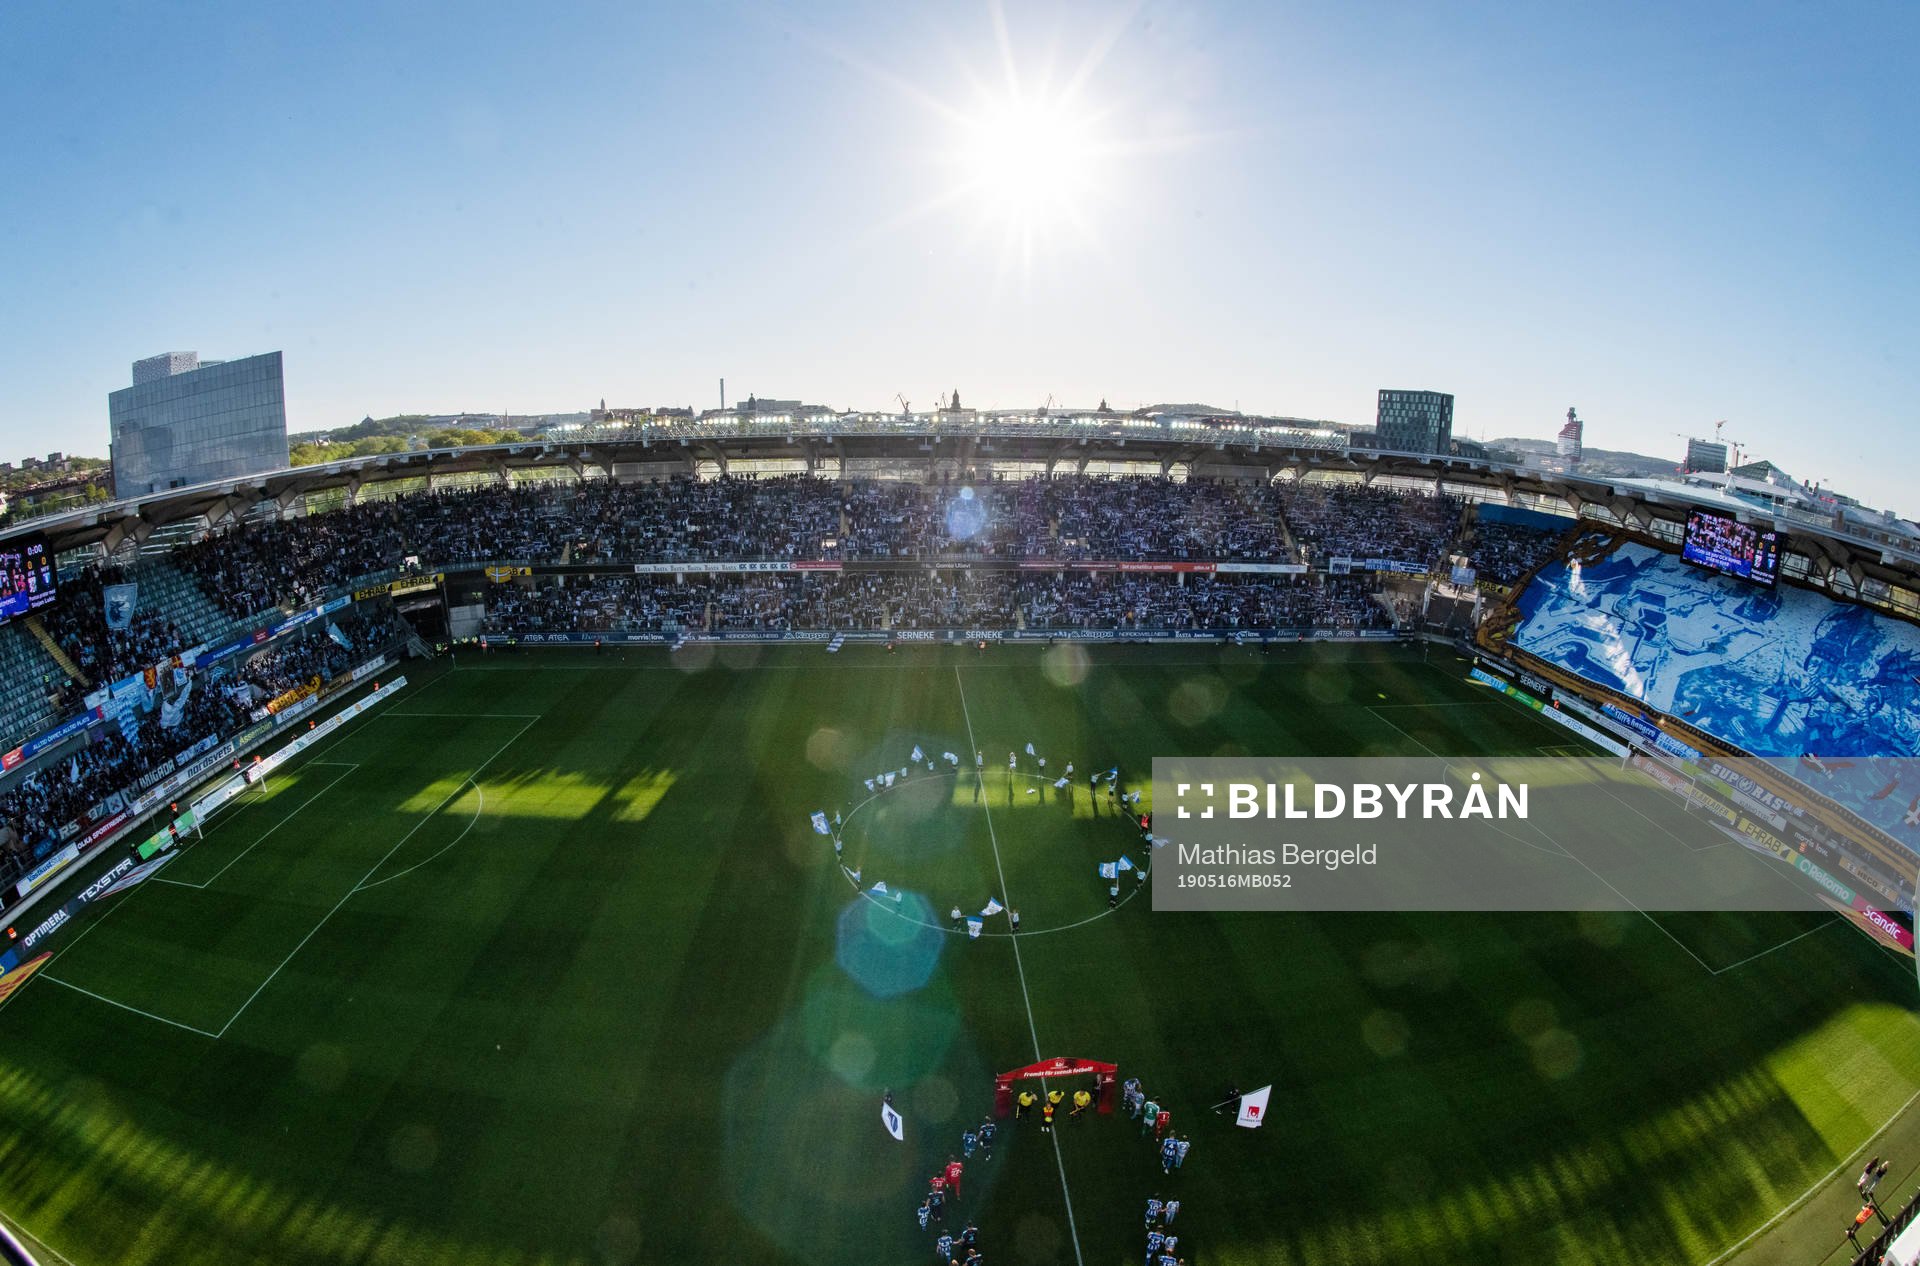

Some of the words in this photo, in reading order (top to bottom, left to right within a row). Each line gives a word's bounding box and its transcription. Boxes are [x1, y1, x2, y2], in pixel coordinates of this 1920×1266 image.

[28, 544, 43, 556] 0:00
[359, 585, 386, 599] EHRAB
[401, 576, 431, 588] EHRAB
[795, 632, 830, 640] Kappa
[897, 632, 935, 640] SERNEKE
[965, 631, 1003, 639] SERNEKE
[1520, 675, 1547, 695] SERNEKE
[187, 743, 232, 778] nordsvets
[1745, 823, 1781, 852] EHRAB
[78, 858, 133, 902] TEXSTAR
[1808, 865, 1850, 901] Rekomo
[24, 908, 68, 947] OPTIMERA
[1863, 904, 1901, 939] Scandic
